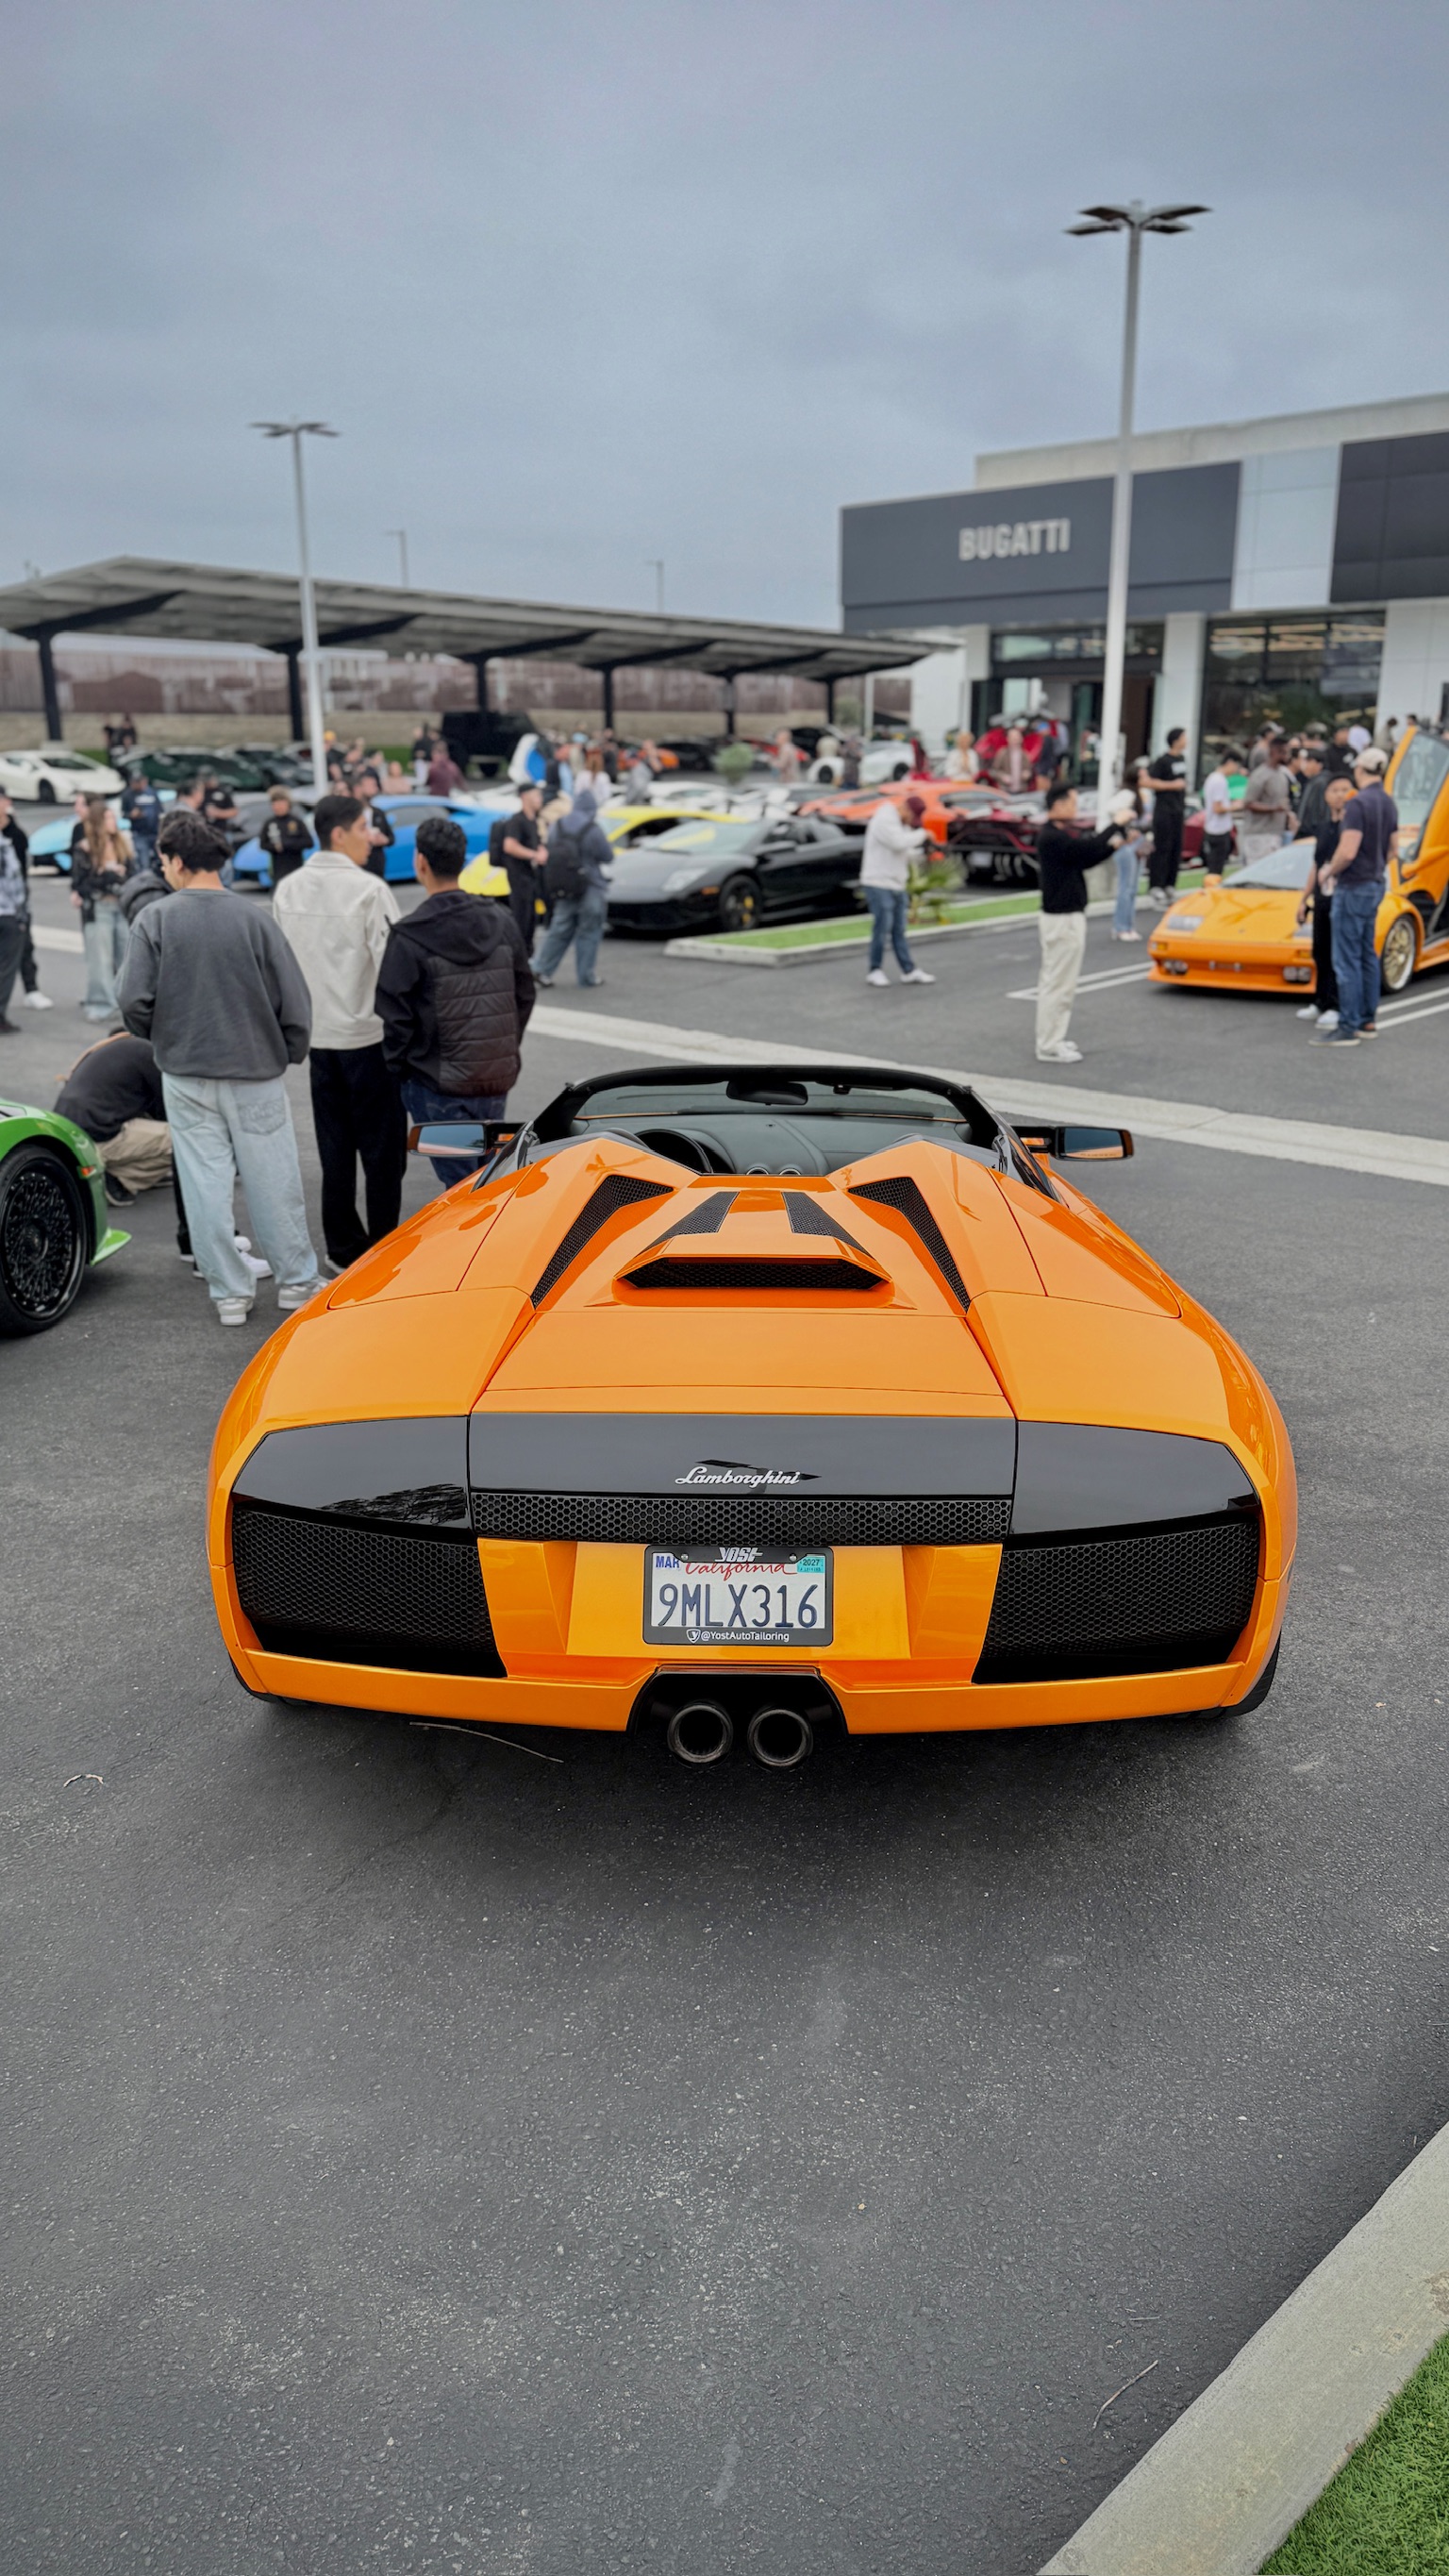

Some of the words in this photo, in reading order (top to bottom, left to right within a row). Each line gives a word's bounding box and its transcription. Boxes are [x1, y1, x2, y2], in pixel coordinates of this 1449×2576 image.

[958, 518, 1071, 560] BUGATTI
[675, 1465, 801, 1489] Lamborghini
[656, 1555, 680, 1569] MAR
[685, 1562, 798, 1581] California
[802, 1558, 820, 1566] 2027
[658, 1582, 819, 1629] 9MLX316
[700, 1631, 790, 1643] @YostAutoTailoring
